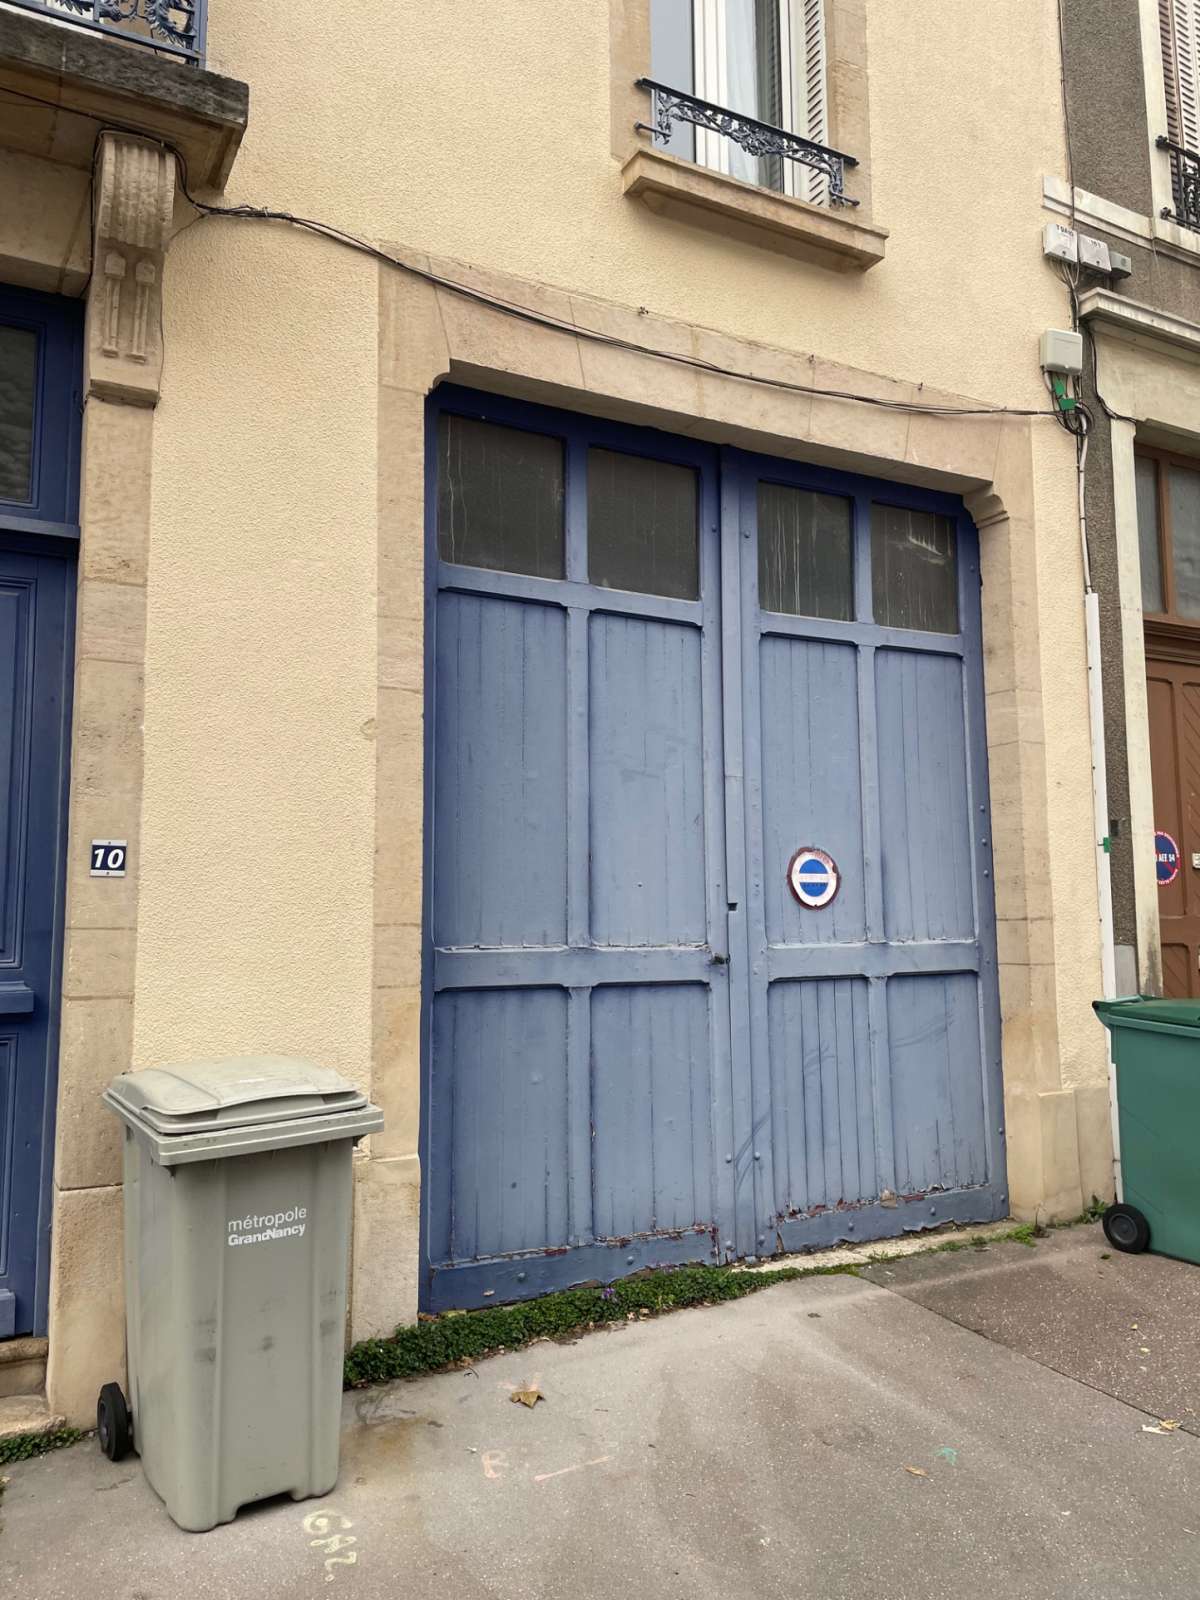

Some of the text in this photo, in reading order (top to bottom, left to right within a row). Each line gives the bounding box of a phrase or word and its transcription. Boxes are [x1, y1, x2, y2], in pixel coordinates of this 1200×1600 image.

[94, 848, 124, 869] 10
[228, 1206, 307, 1232] métropole
[228, 1223, 306, 1246] GrandNancy
